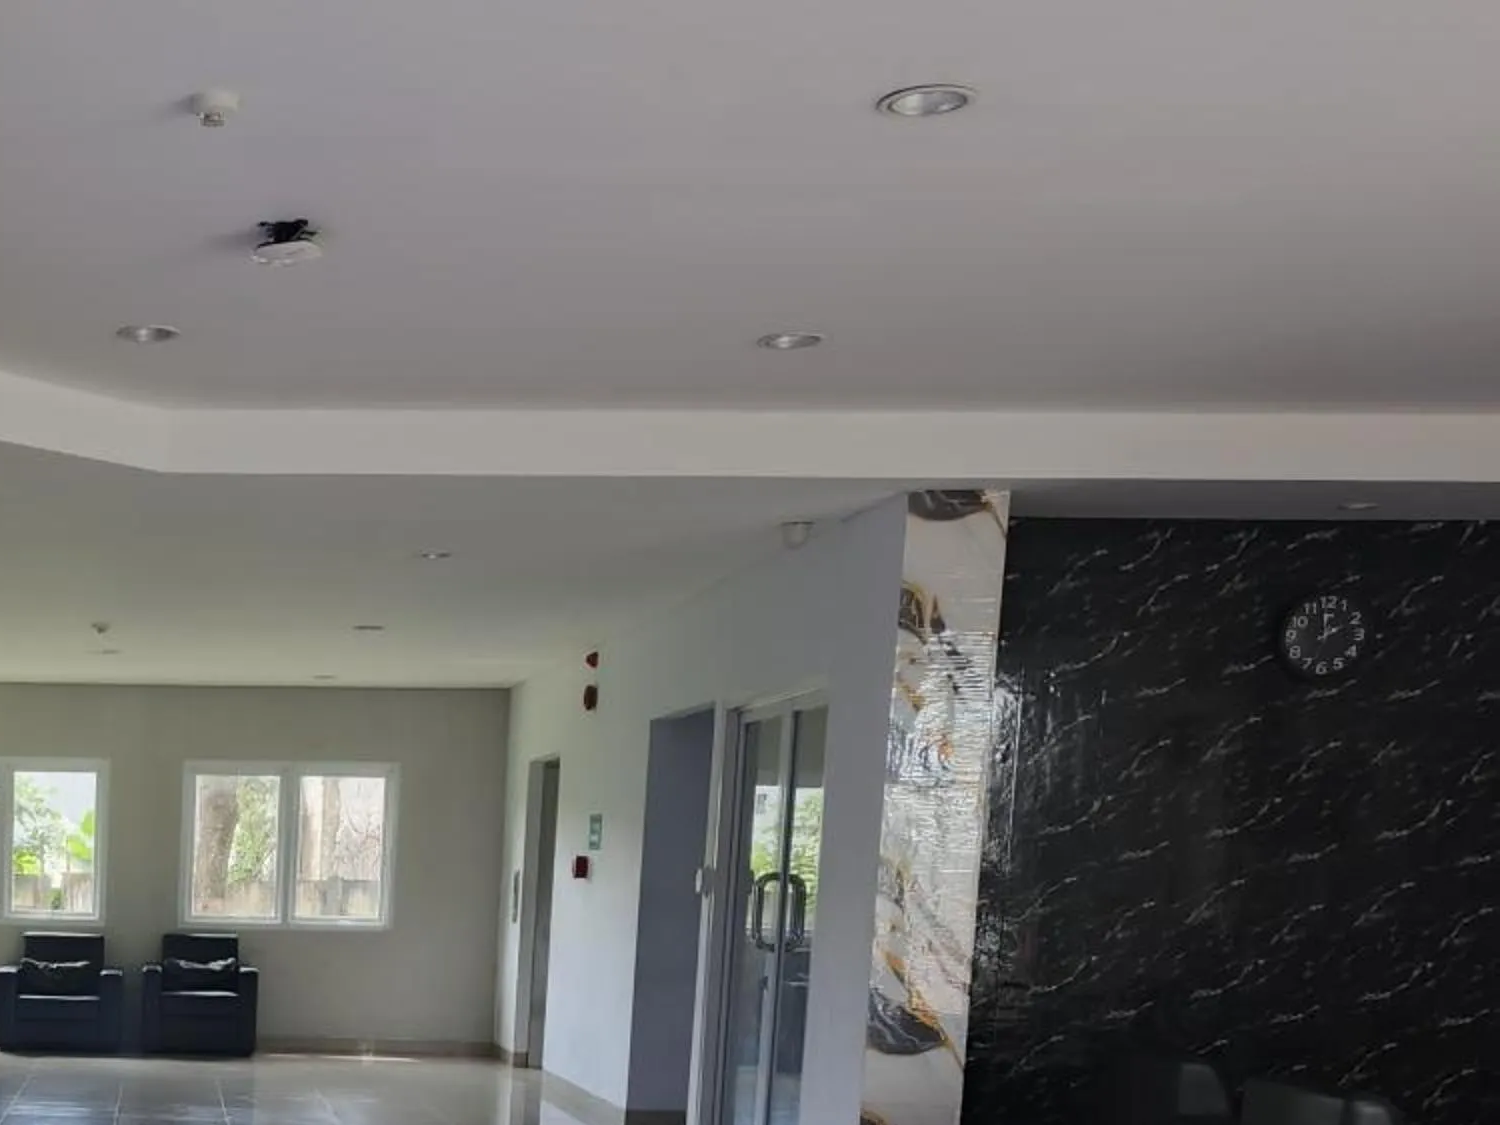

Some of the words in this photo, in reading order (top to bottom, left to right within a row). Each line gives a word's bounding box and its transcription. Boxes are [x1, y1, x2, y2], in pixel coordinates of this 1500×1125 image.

[1304, 602, 1317, 615] 11
[1320, 595, 1338, 609] 12
[1341, 599, 1348, 611] 1
[1292, 615, 1309, 629] 10
[1349, 611, 1362, 625] 2
[1285, 629, 1297, 643] 9
[1353, 627, 1365, 641] 3
[1289, 645, 1301, 659] 8
[1344, 644, 1357, 657] 4
[1302, 657, 1313, 670] 7
[1315, 661, 1328, 675] 6
[1332, 657, 1345, 671] 5
